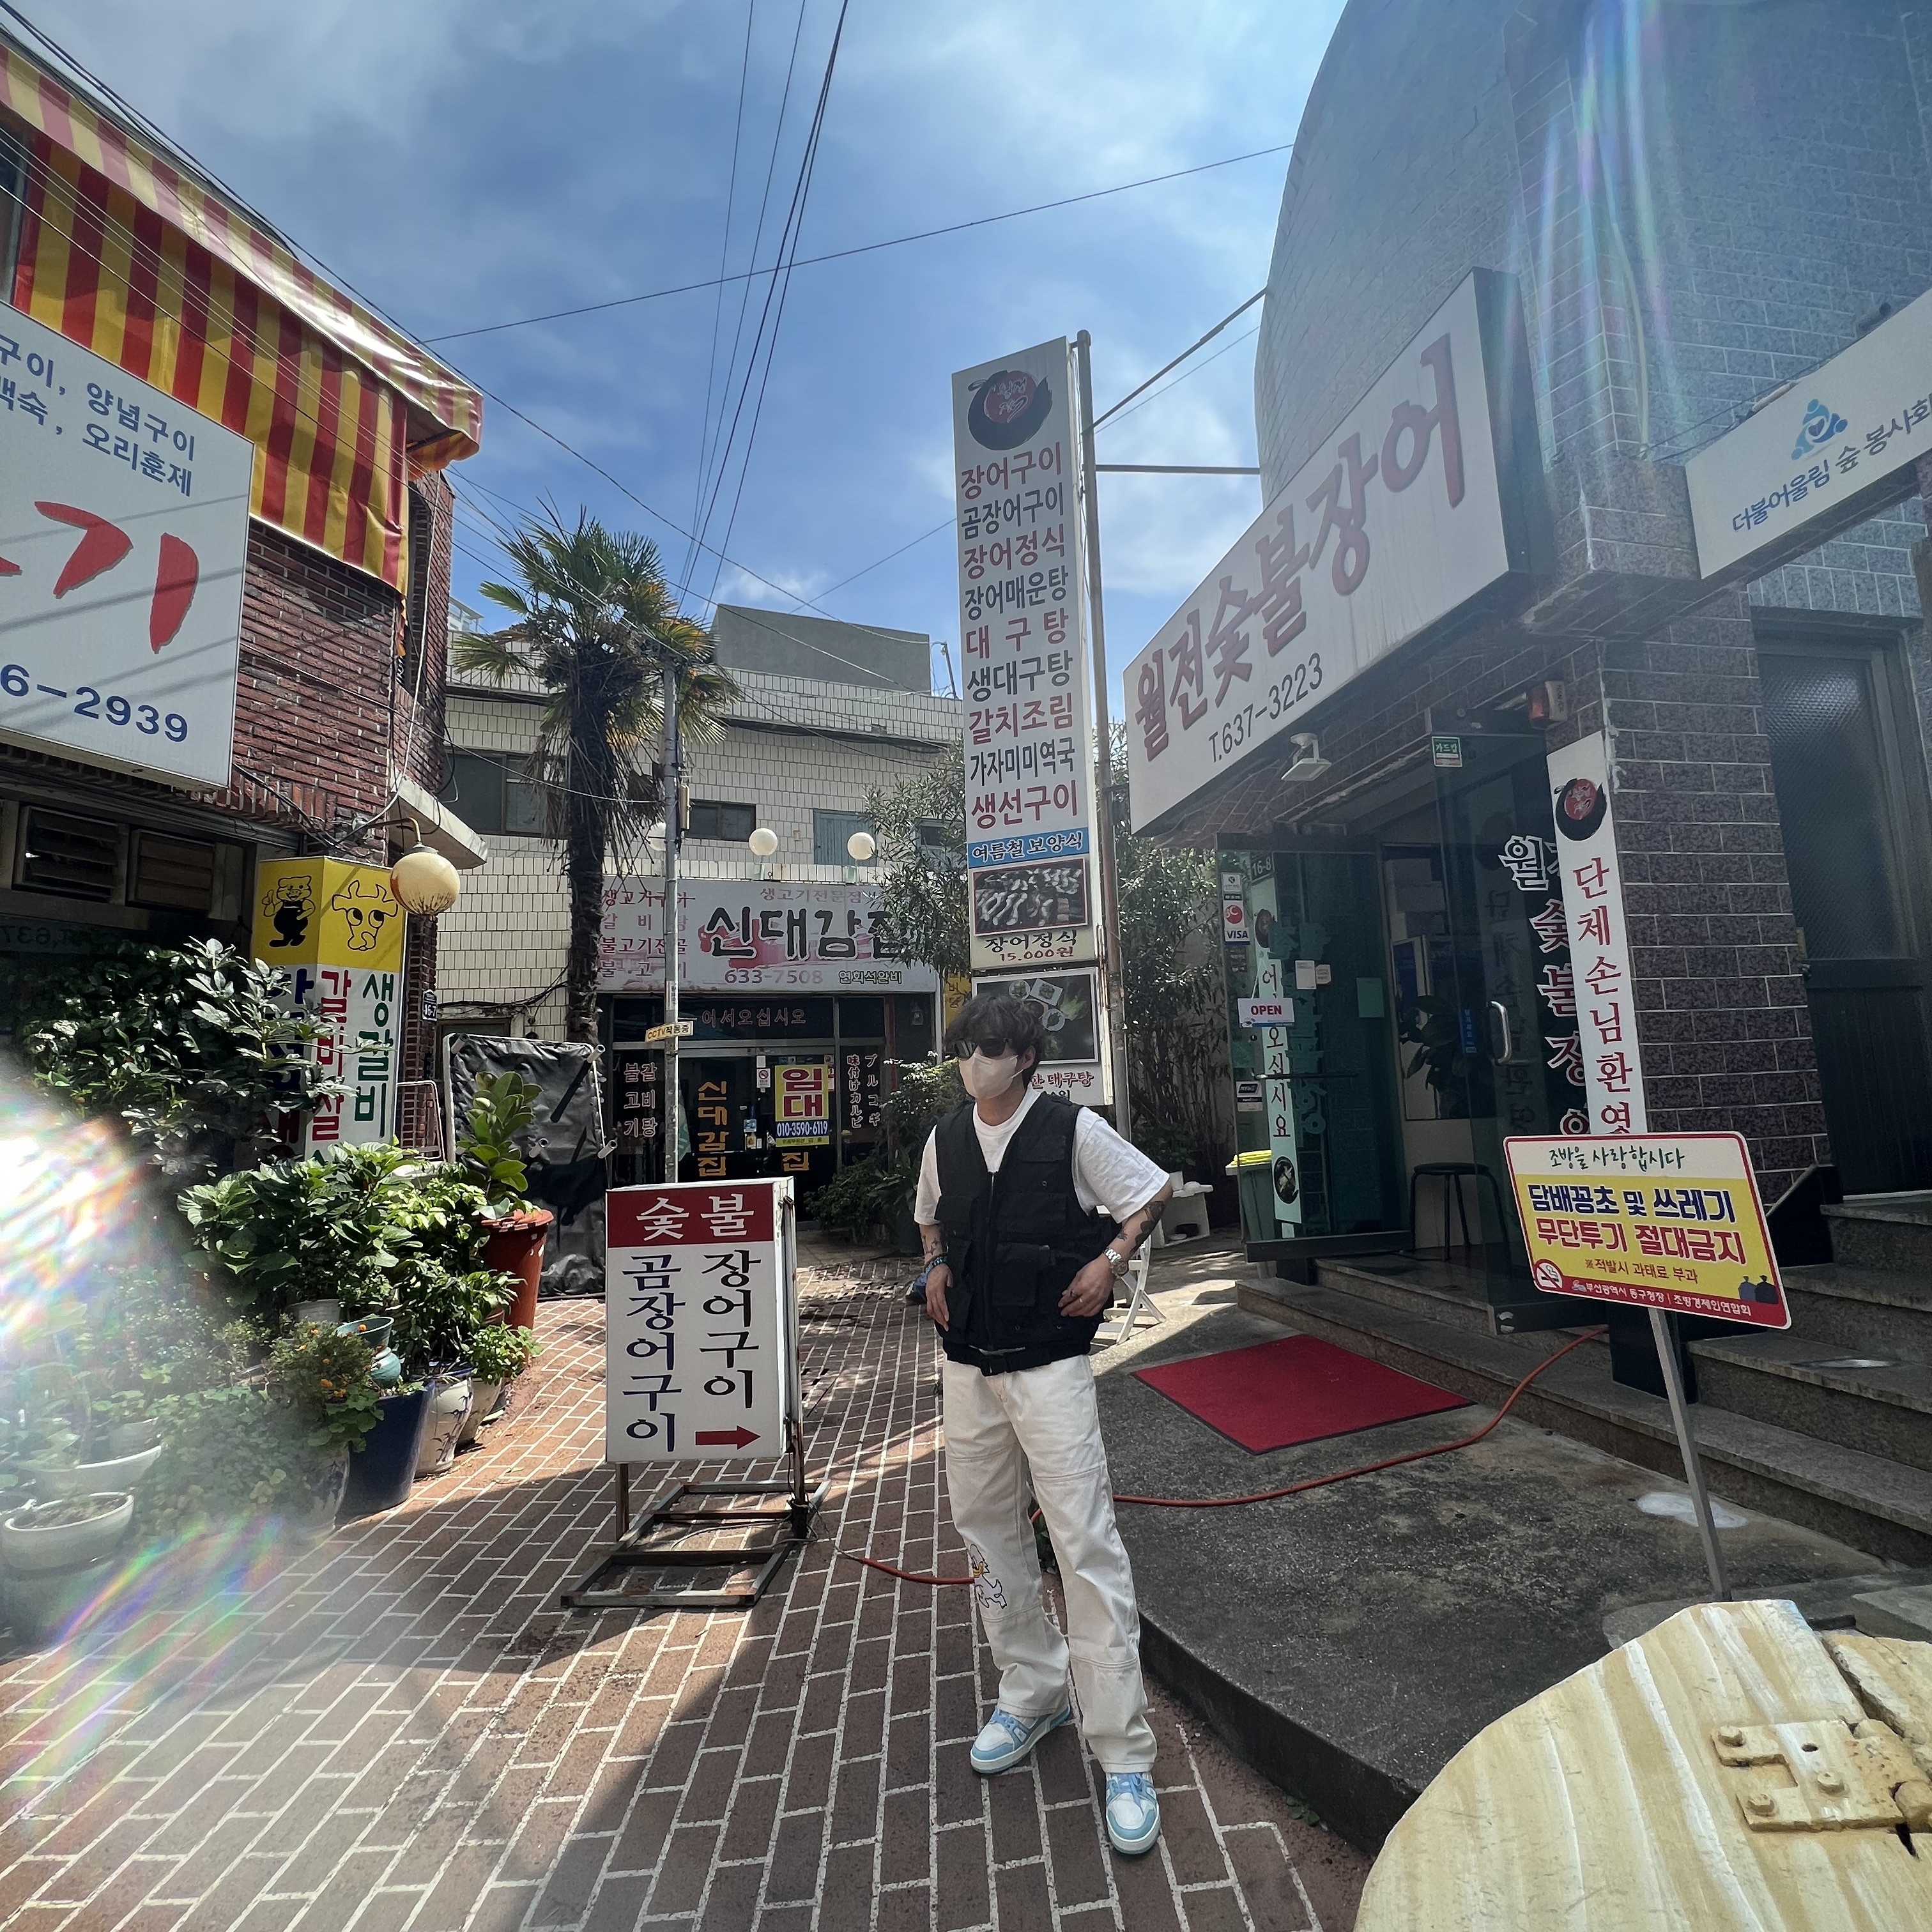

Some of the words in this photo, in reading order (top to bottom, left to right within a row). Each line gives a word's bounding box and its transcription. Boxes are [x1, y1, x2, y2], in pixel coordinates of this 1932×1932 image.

[87, 383, 195, 461] 양념구이
[82, 423, 192, 497] 오리훈제
[961, 441, 1061, 500] 장어구이
[1733, 459, 1830, 531] 더불어울림
[1835, 445, 1861, 474] 숲
[1863, 393, 1932, 456] 봉사회
[961, 482, 1064, 540] 곰장어구이
[963, 523, 1065, 579] 장어정식
[1136, 333, 1465, 762] 월전숯불장어
[965, 565, 1068, 620] 장어매운탕
[967, 650, 1073, 702] 생대구탕
[969, 693, 1073, 746] 갈치조림
[1209, 653, 1323, 763] T.637-3223
[970, 737, 1075, 786] 가자미미역국
[971, 779, 1077, 829] 생선구이
[972, 839, 1023, 862] 여름철
[1029, 832, 1084, 856] 보양식
[1252, 856, 1272, 876] 16-8
[760, 887, 861, 903] 생고기전문점
[985, 930, 1078, 954] 장어정식
[999, 946, 1075, 962] 15.000원
[1227, 930, 1248, 939] VISA
[724, 969, 824, 985] 633-7508
[838, 970, 902, 985] 연회석완비
[1573, 857, 1633, 1133] 단체손님환영
[424, 1004, 436, 1017] 16-7
[647, 1024, 689, 1039] CCTV작동중
[702, 1008, 806, 1027] 어서오십시오
[1250, 1005, 1282, 1015] OPEN
[311, 969, 352, 1141] 갈비살
[354, 973, 394, 1137] 생갈비
[1262, 963, 1291, 1138] 어오십시요
[781, 1068, 824, 1117] 임대
[847, 1054, 864, 1129] 味付けカルビ
[1046, 1071, 1094, 1088] 대구탕
[697, 1080, 730, 1177] 신대감집
[1549, 1147, 1589, 1170] 조방을
[1592, 1145, 1685, 1172] 사랑합시다
[636, 1193, 755, 1241] 숯불
[1528, 1184, 1620, 1215] 담배꽁초
[1623, 1190, 1648, 1217] 및
[1652, 1187, 1736, 1223] 쓰레기
[1536, 1217, 1629, 1253] 무단투기
[1634, 1223, 1747, 1266] 절대금지
[1632, 1262, 1669, 1280] 과태료
[1672, 1266, 1699, 1284] 부과
[1586, 1282, 1628, 1298] 부산광역시
[1673, 1294, 1752, 1317] 조방경제인연합회
[622, 1254, 686, 1453] 곰장어구이
[699, 1249, 762, 1409] 장어구이
